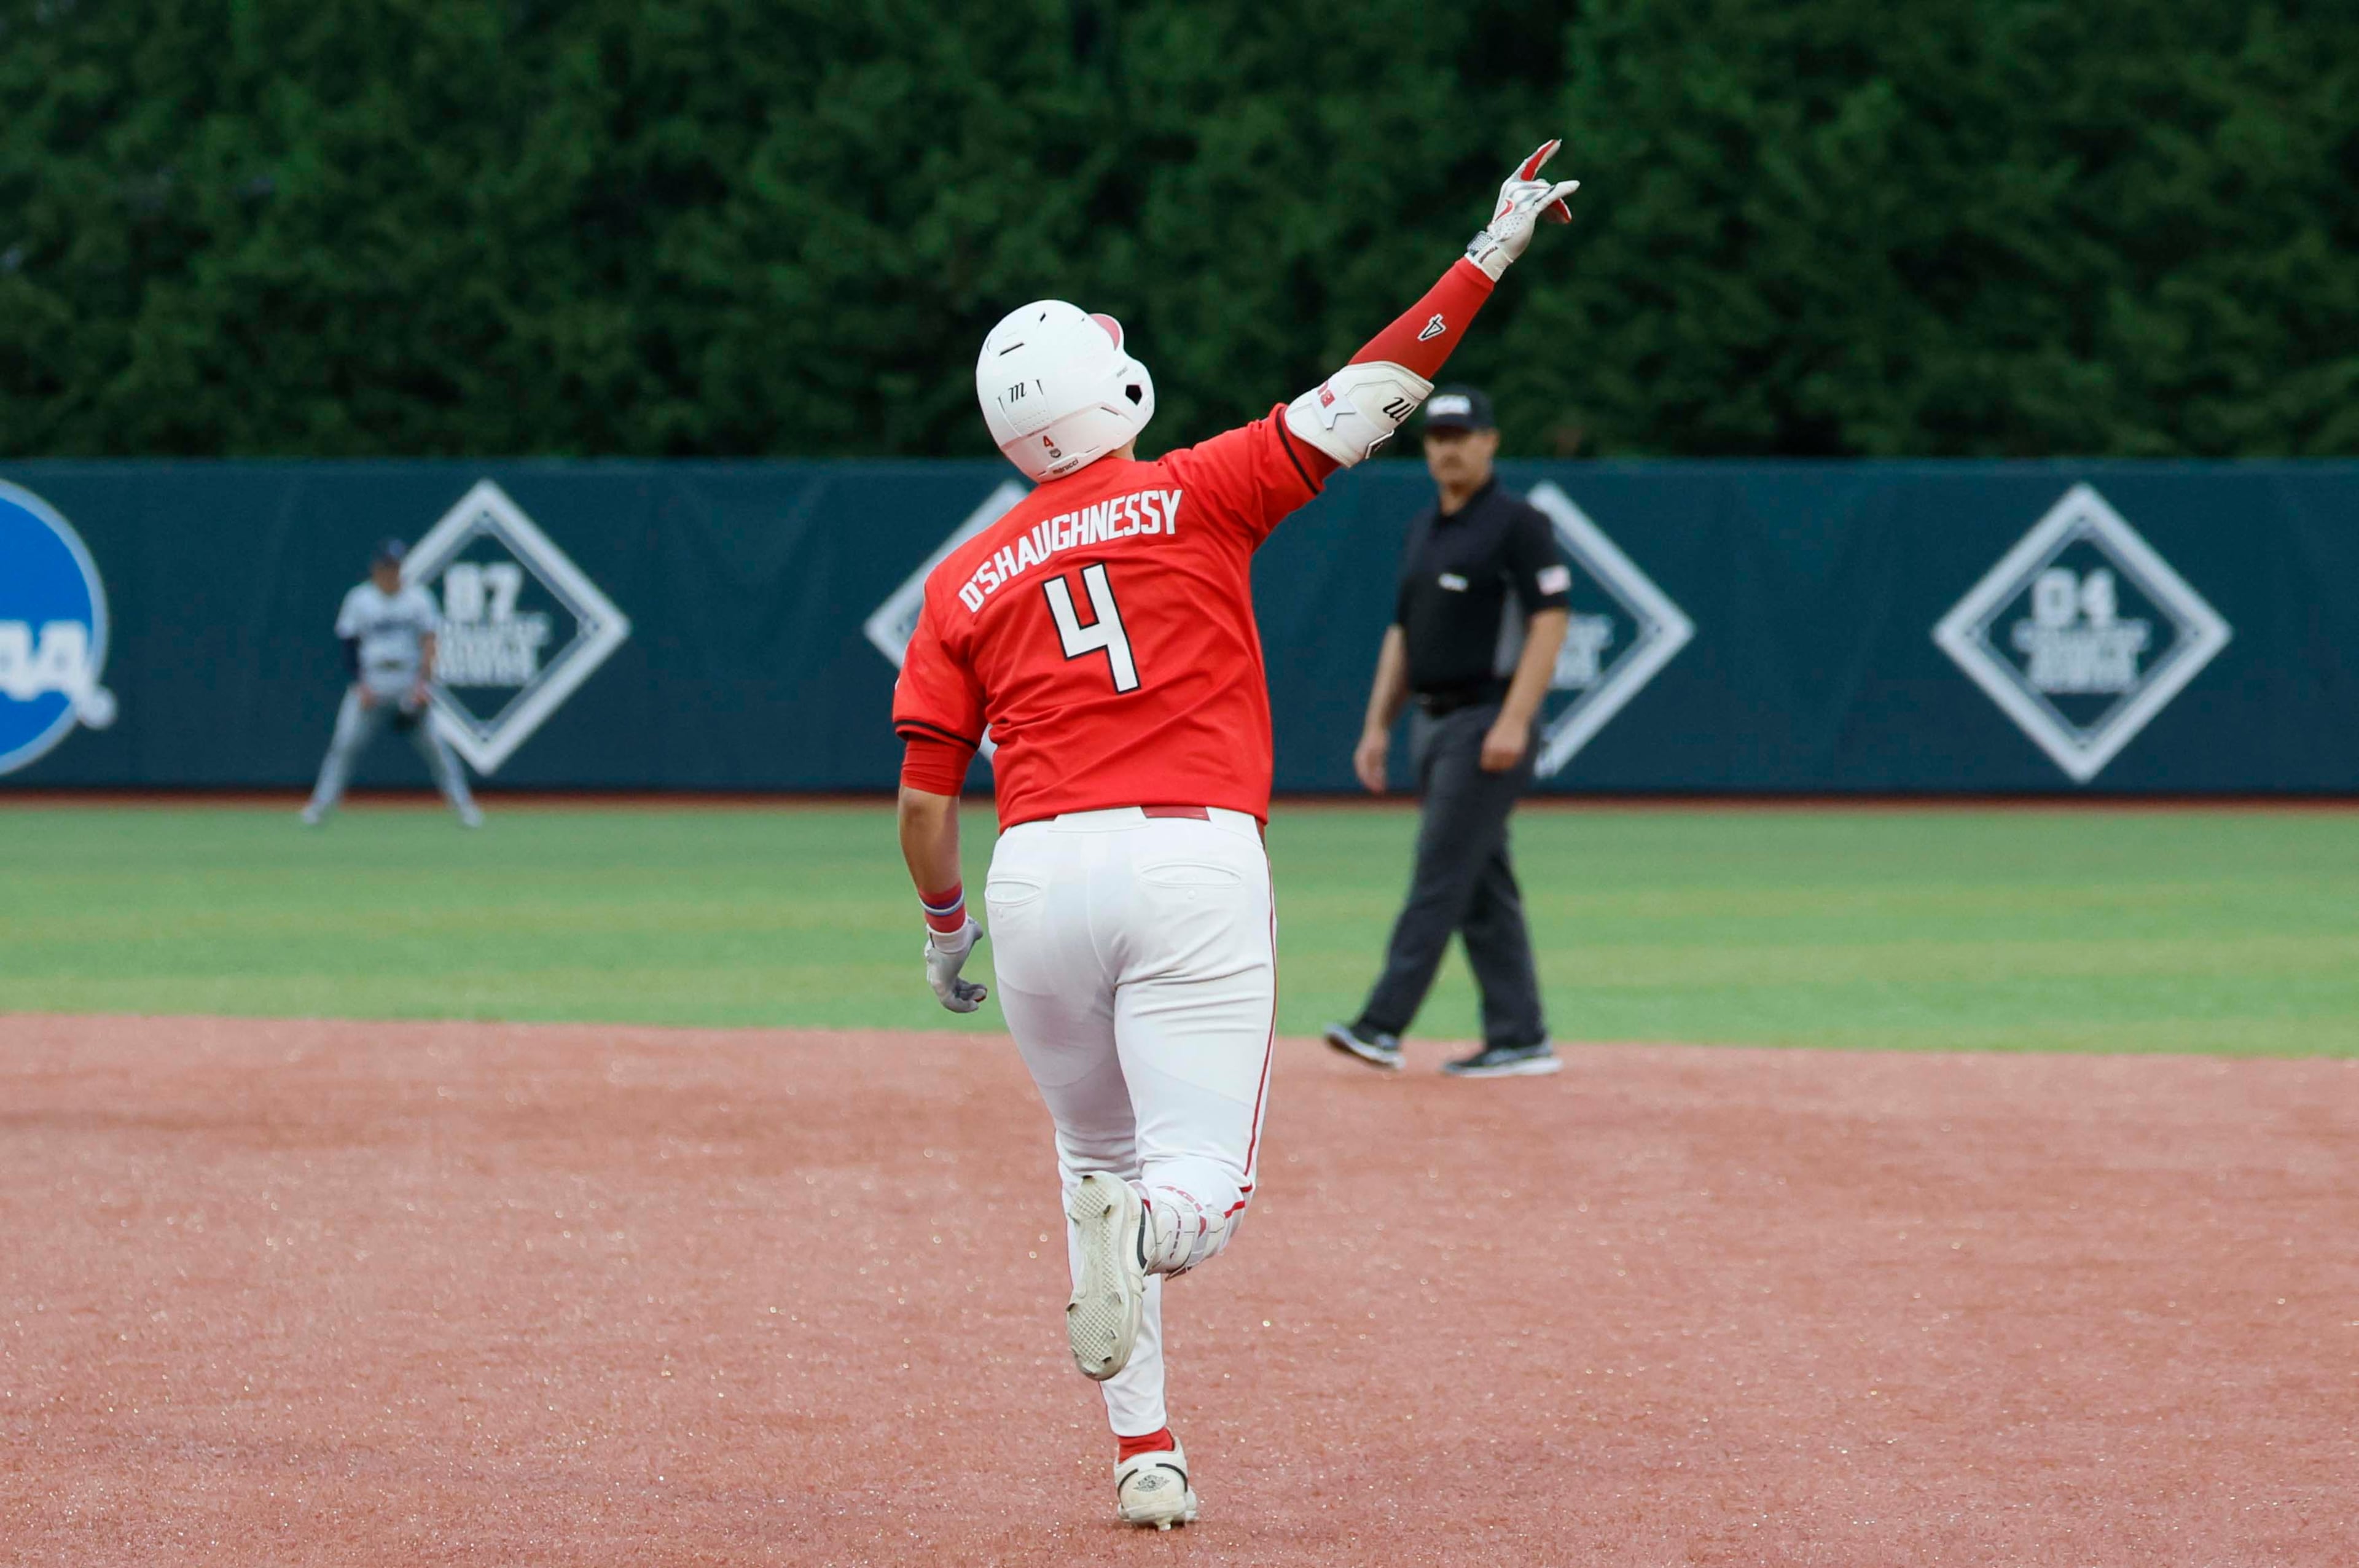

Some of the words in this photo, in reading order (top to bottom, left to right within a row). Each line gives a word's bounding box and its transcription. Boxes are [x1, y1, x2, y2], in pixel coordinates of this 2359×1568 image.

[1417, 313, 1446, 341] 4
[1043, 435, 1054, 448] 4
[958, 490, 1183, 613] O'SHAUGHNESSY
[1042, 561, 1141, 695] 4
